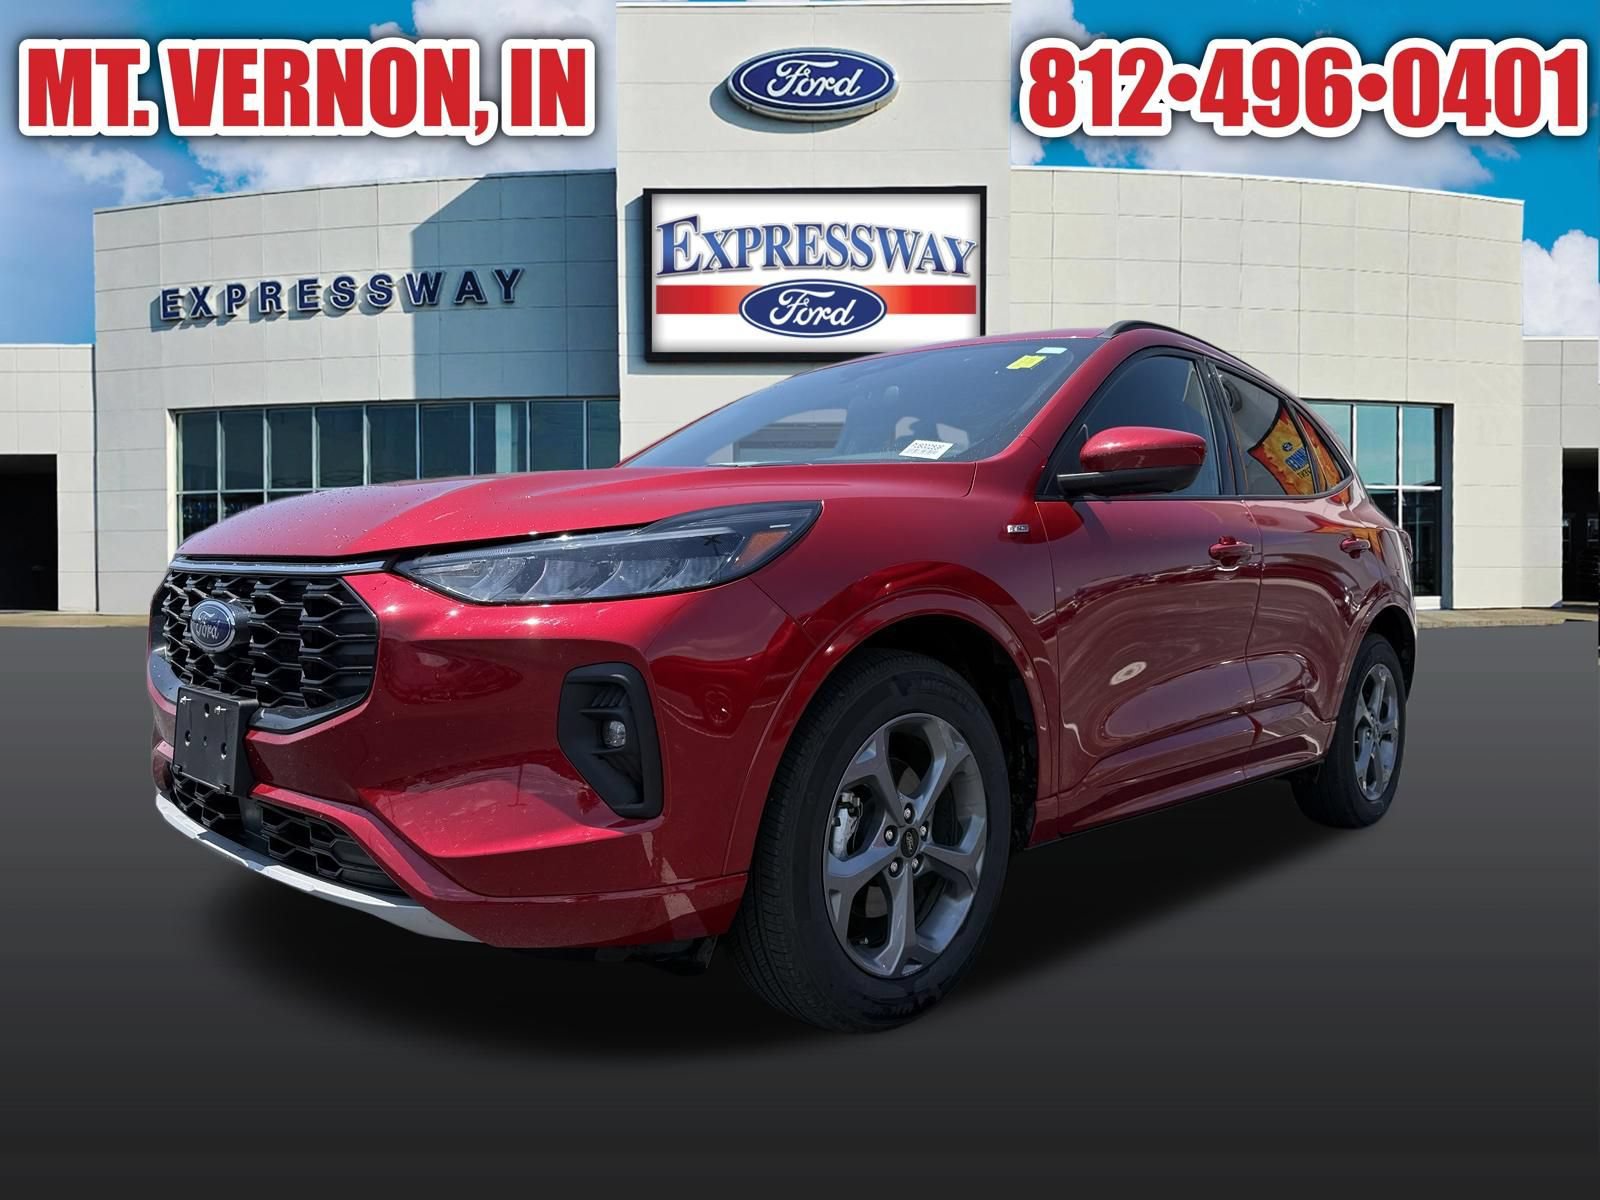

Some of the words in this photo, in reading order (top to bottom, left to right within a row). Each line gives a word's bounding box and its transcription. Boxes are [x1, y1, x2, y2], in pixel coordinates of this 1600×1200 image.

[767, 59, 864, 98] Ford
[159, 267, 525, 322] EXPRESSWAY
[769, 288, 857, 327] Ford
